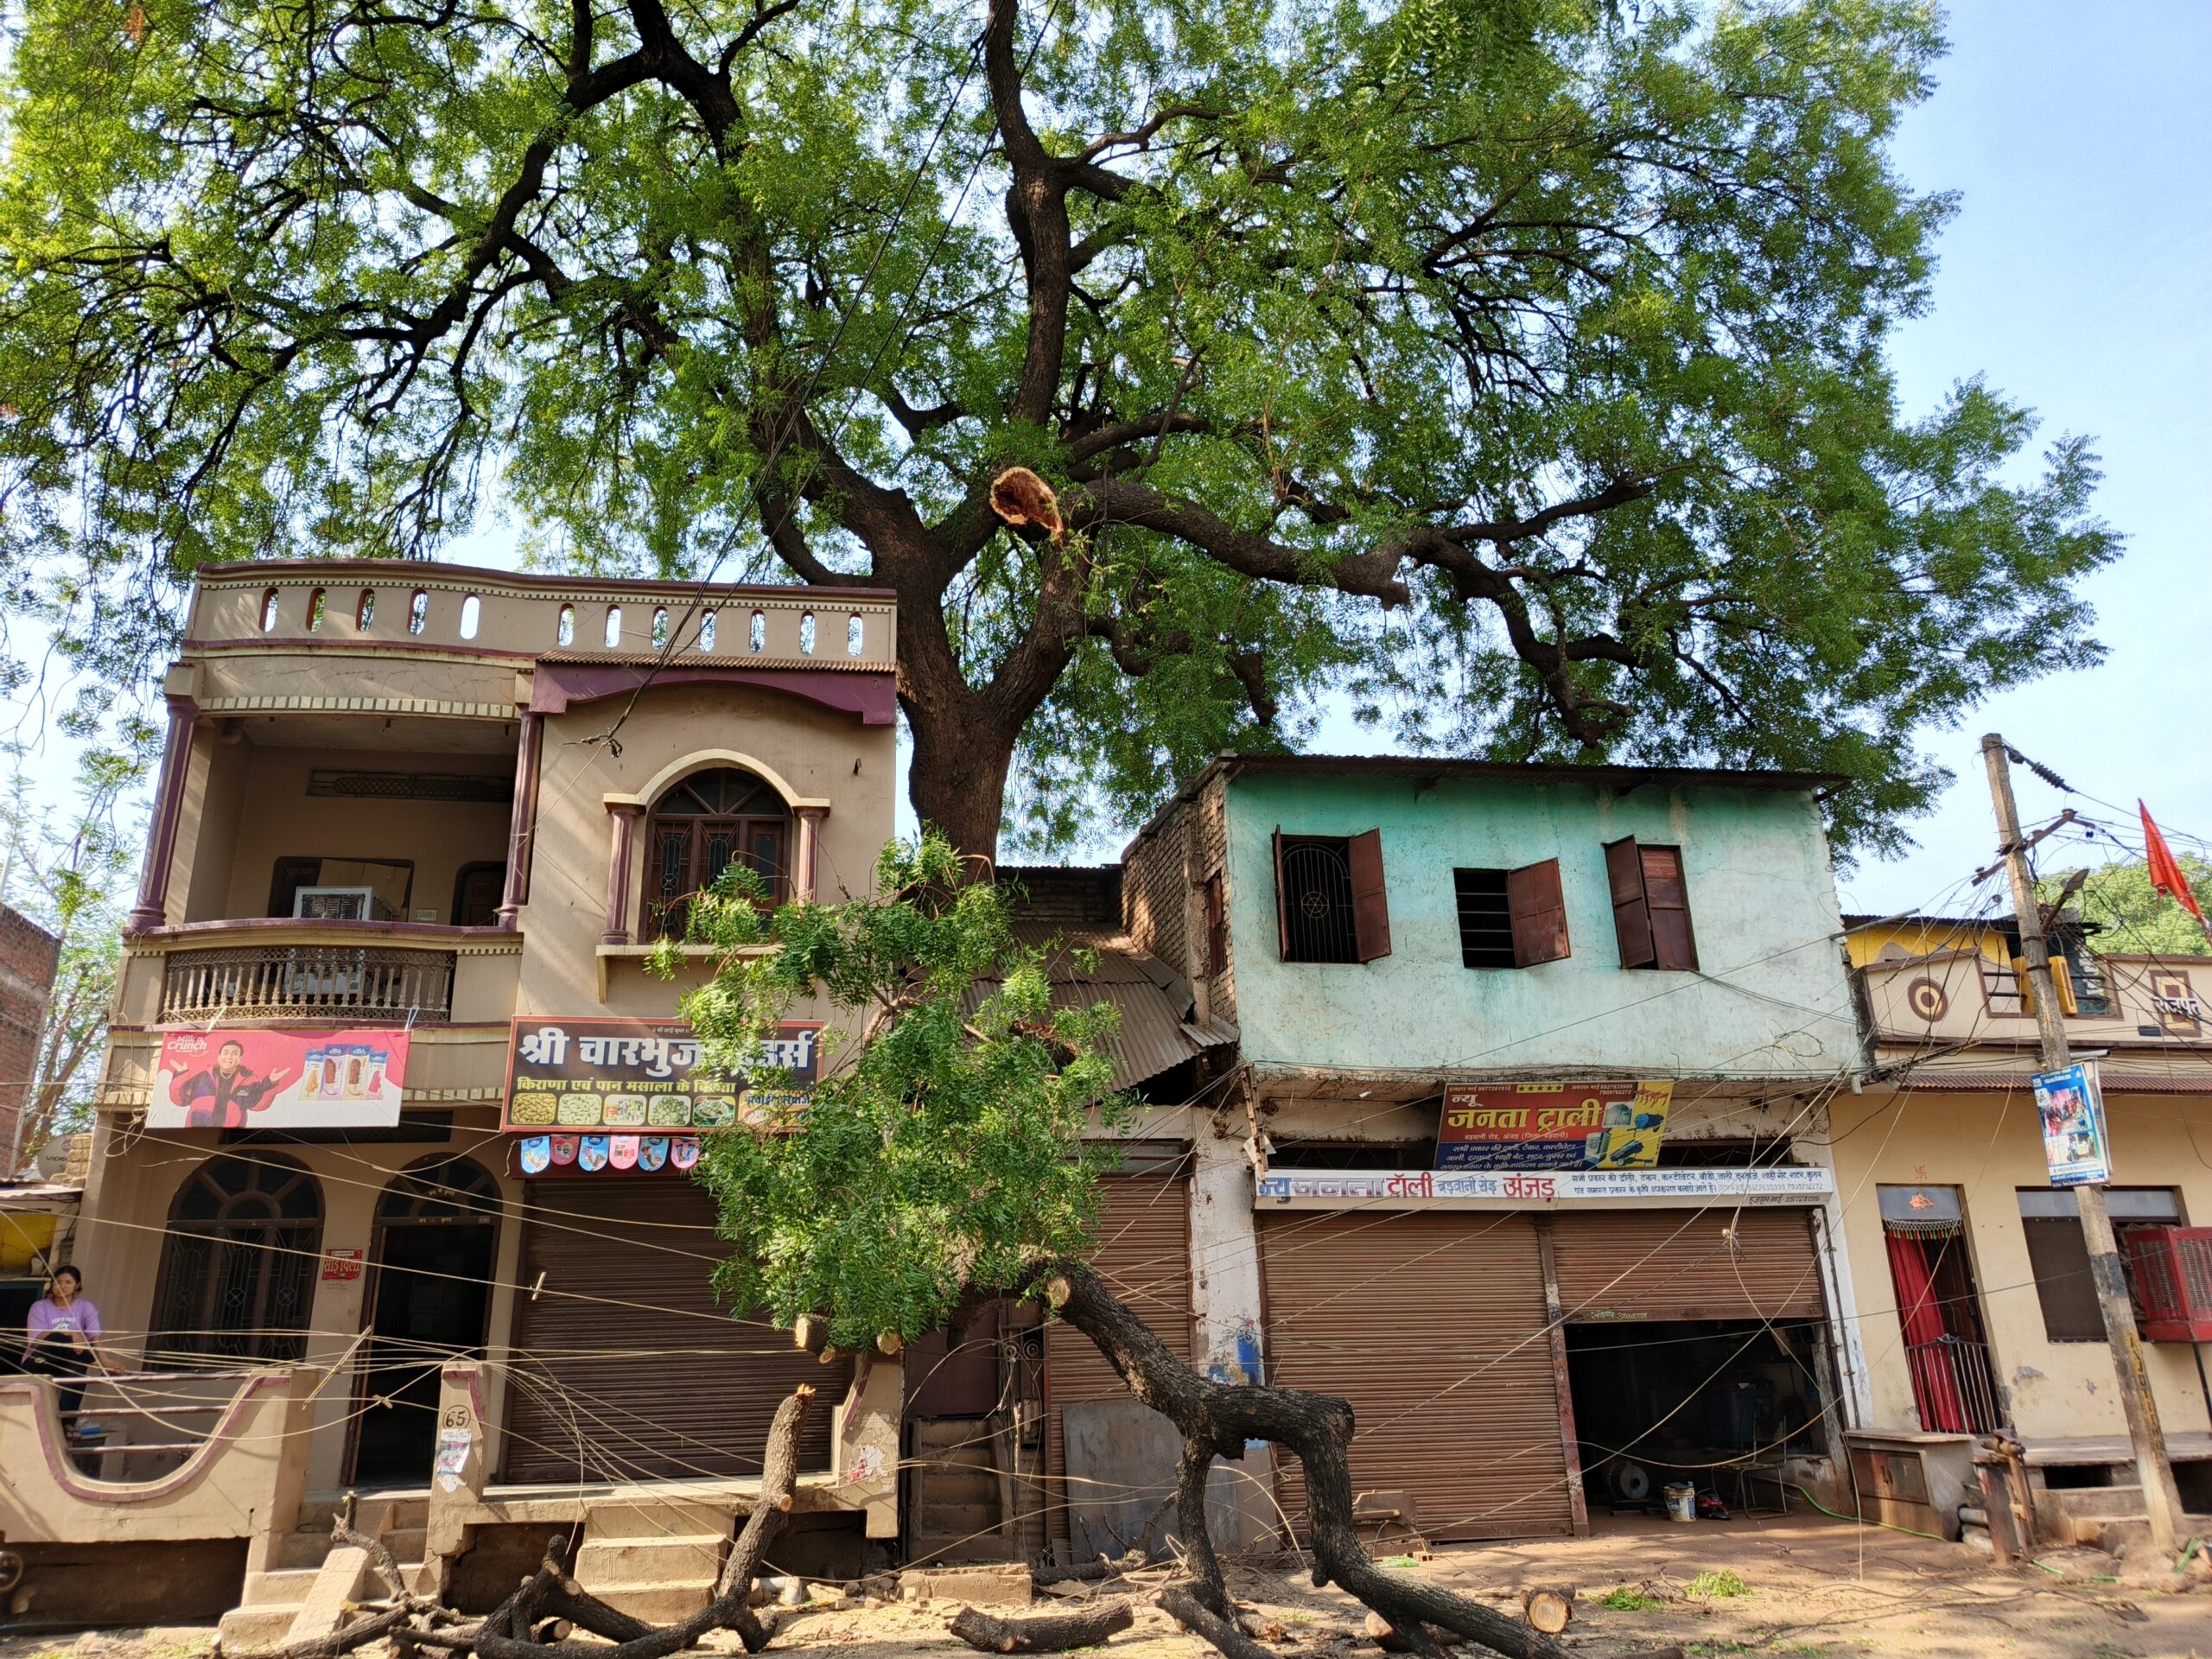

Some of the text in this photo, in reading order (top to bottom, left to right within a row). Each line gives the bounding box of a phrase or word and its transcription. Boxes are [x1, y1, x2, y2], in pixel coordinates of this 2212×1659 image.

[167, 1040, 208, 1051] Crunch
[518, 1027, 570, 1065] श्री
[579, 1037, 709, 1077] चारभुज
[517, 1077, 569, 1091] किराणा
[571, 1077, 594, 1091] एवं
[596, 1080, 624, 1092] पान
[626, 1081, 674, 1093] मसाला
[677, 1078, 690, 1093] के
[1451, 1094, 1484, 1107] न्यू
[1447, 1097, 1603, 1133] जनता ट्राली
[1292, 1177, 1385, 1198] जनता
[1386, 1172, 1434, 1198] ट्रॉली
[1587, 1173, 1605, 1183] प्रकार
[1607, 1172, 1617, 1183] की
[1608, 1185, 1627, 1194] प्रकार
[1628, 1184, 1636, 1193] के
[1651, 1185, 1676, 1194] उपकरण
[445, 1410, 467, 1427] 65
